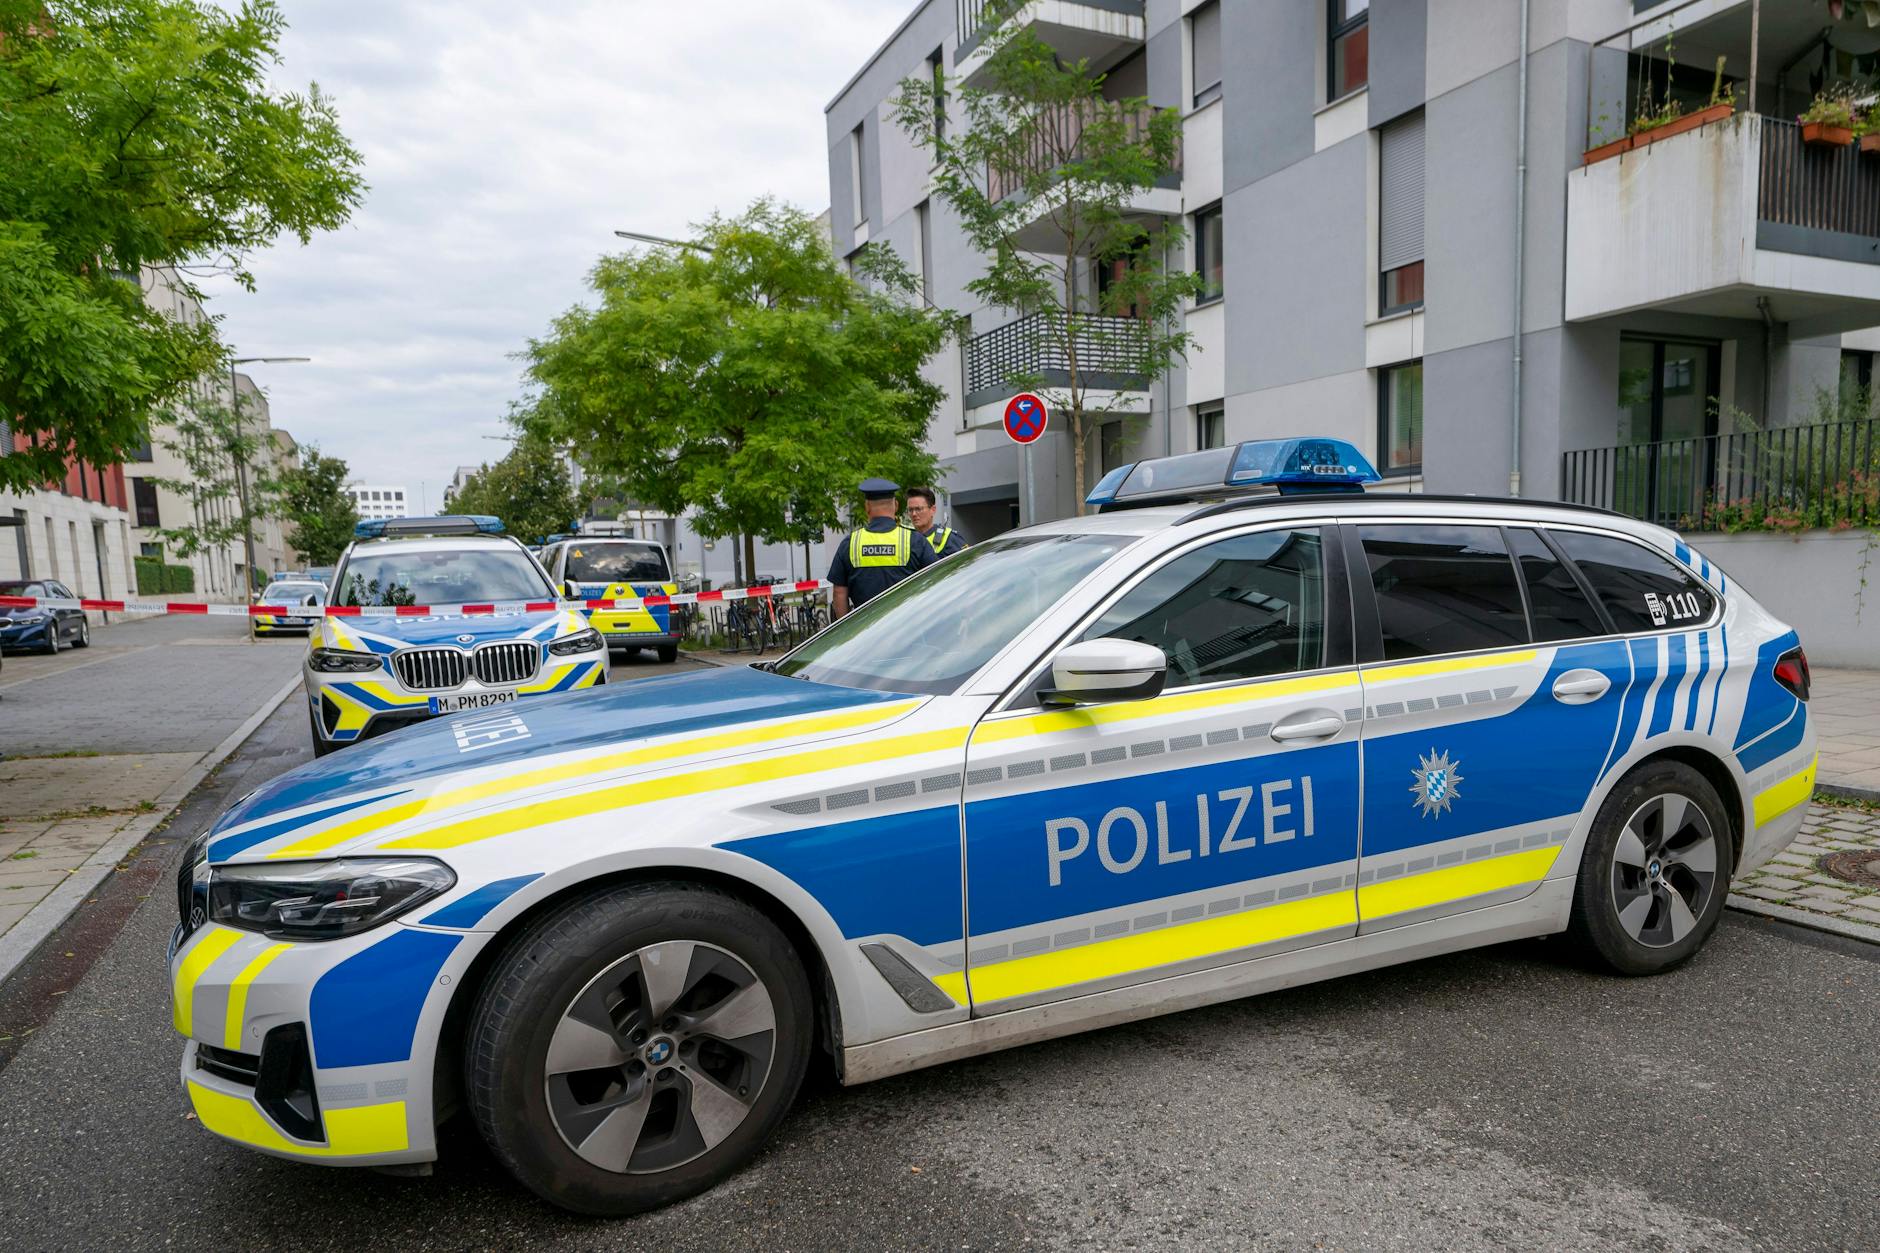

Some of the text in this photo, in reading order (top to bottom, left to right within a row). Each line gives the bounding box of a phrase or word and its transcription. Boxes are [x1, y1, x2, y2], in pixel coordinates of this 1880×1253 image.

[862, 546, 895, 555] POLIZEI
[1666, 592, 1700, 620] 110
[438, 692, 514, 711] M PM 8291
[1045, 775, 1314, 887] POLIZEI
